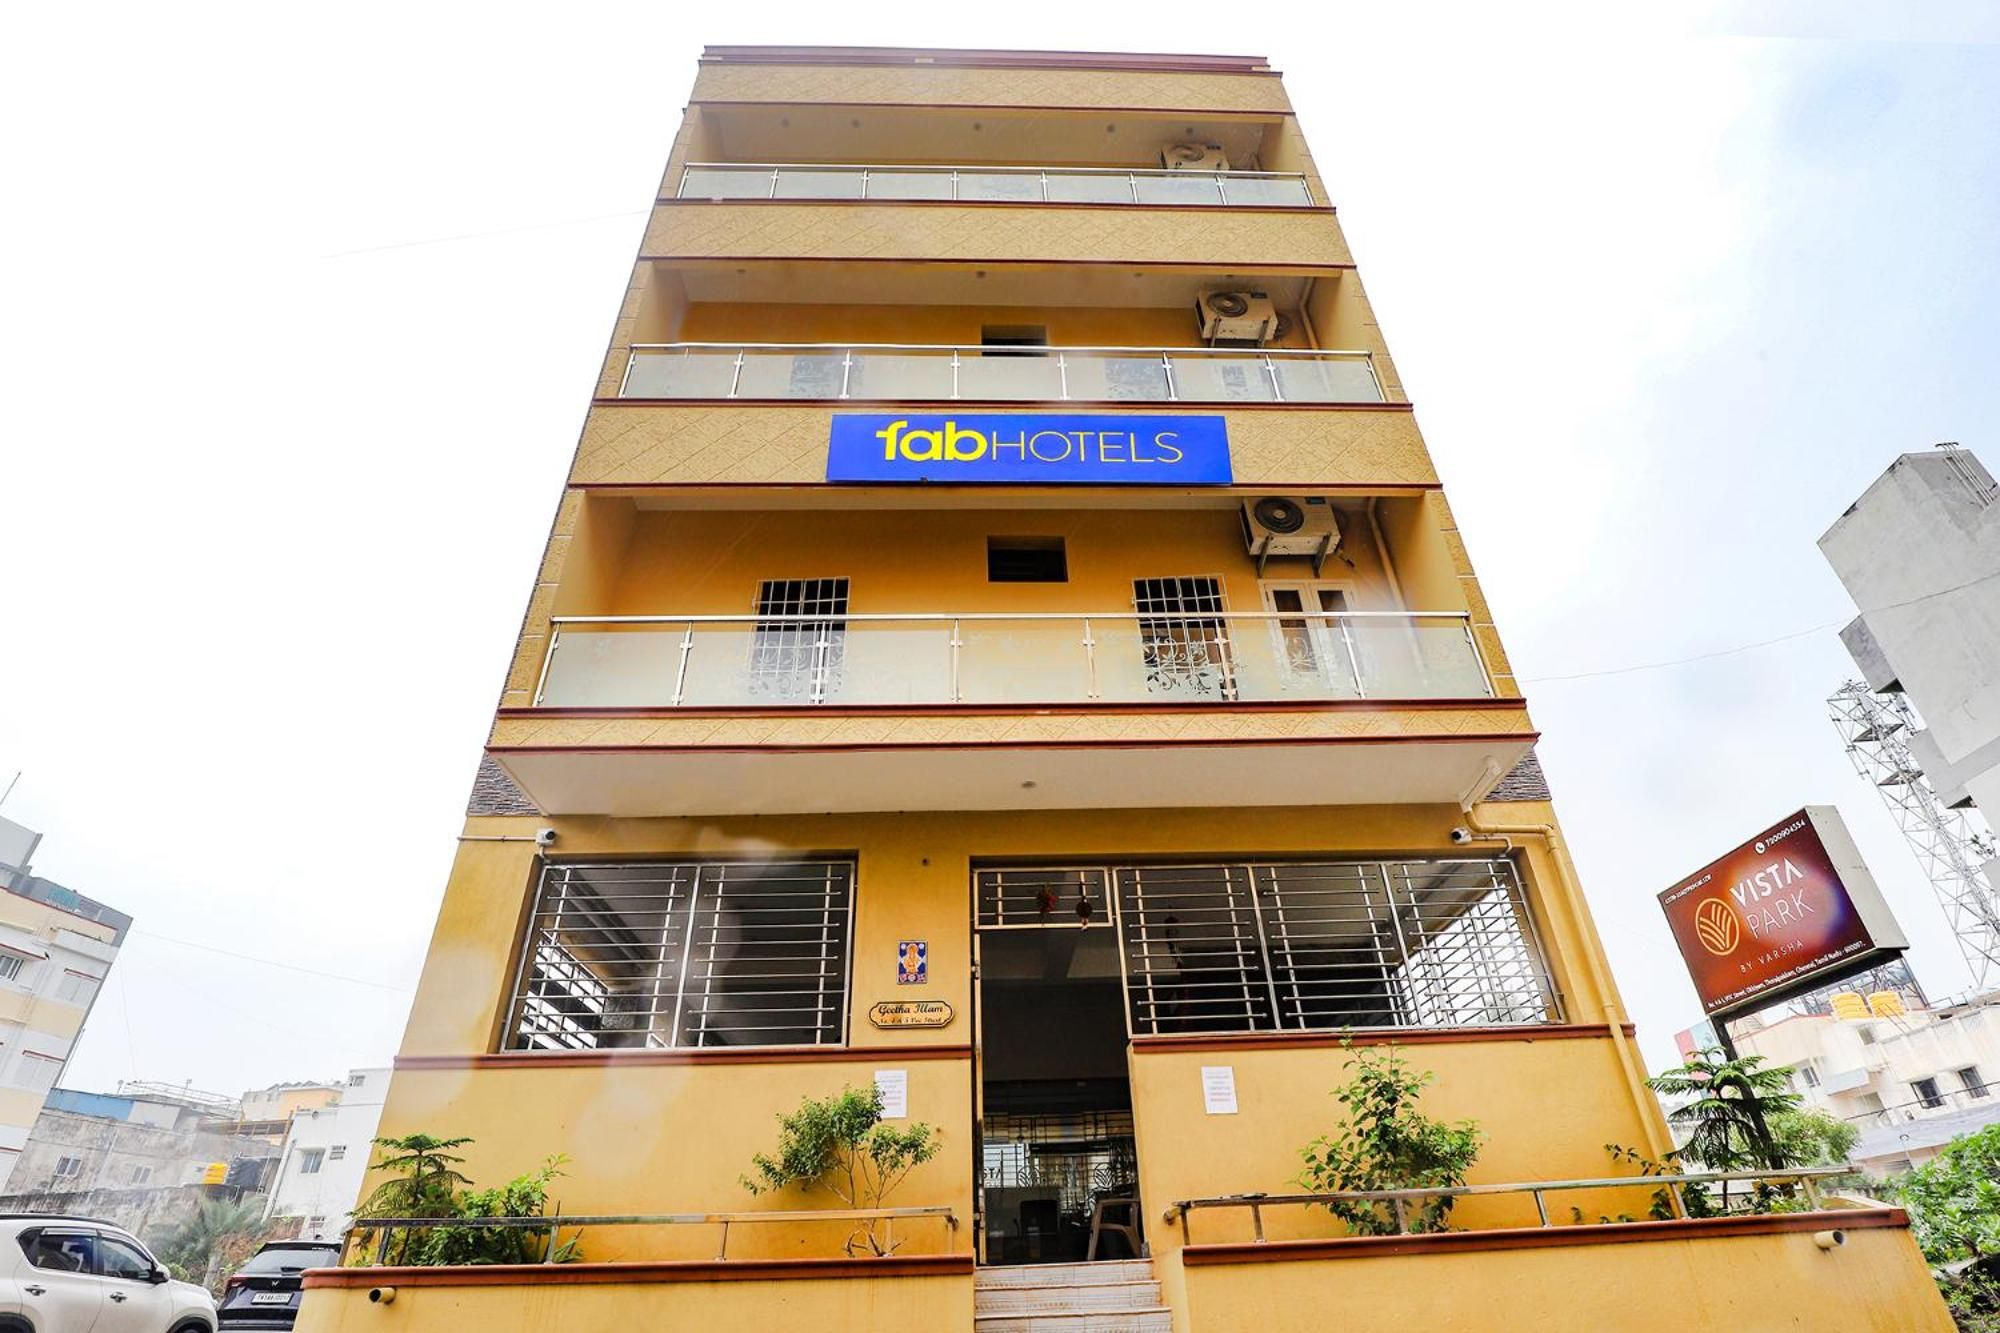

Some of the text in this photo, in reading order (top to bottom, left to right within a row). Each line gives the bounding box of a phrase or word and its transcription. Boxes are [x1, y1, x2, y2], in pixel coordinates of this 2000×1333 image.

[1729, 857, 1803, 907] VISTA
[1746, 888, 1815, 938] PARK
[1740, 939, 1804, 973] BY VARSHA
